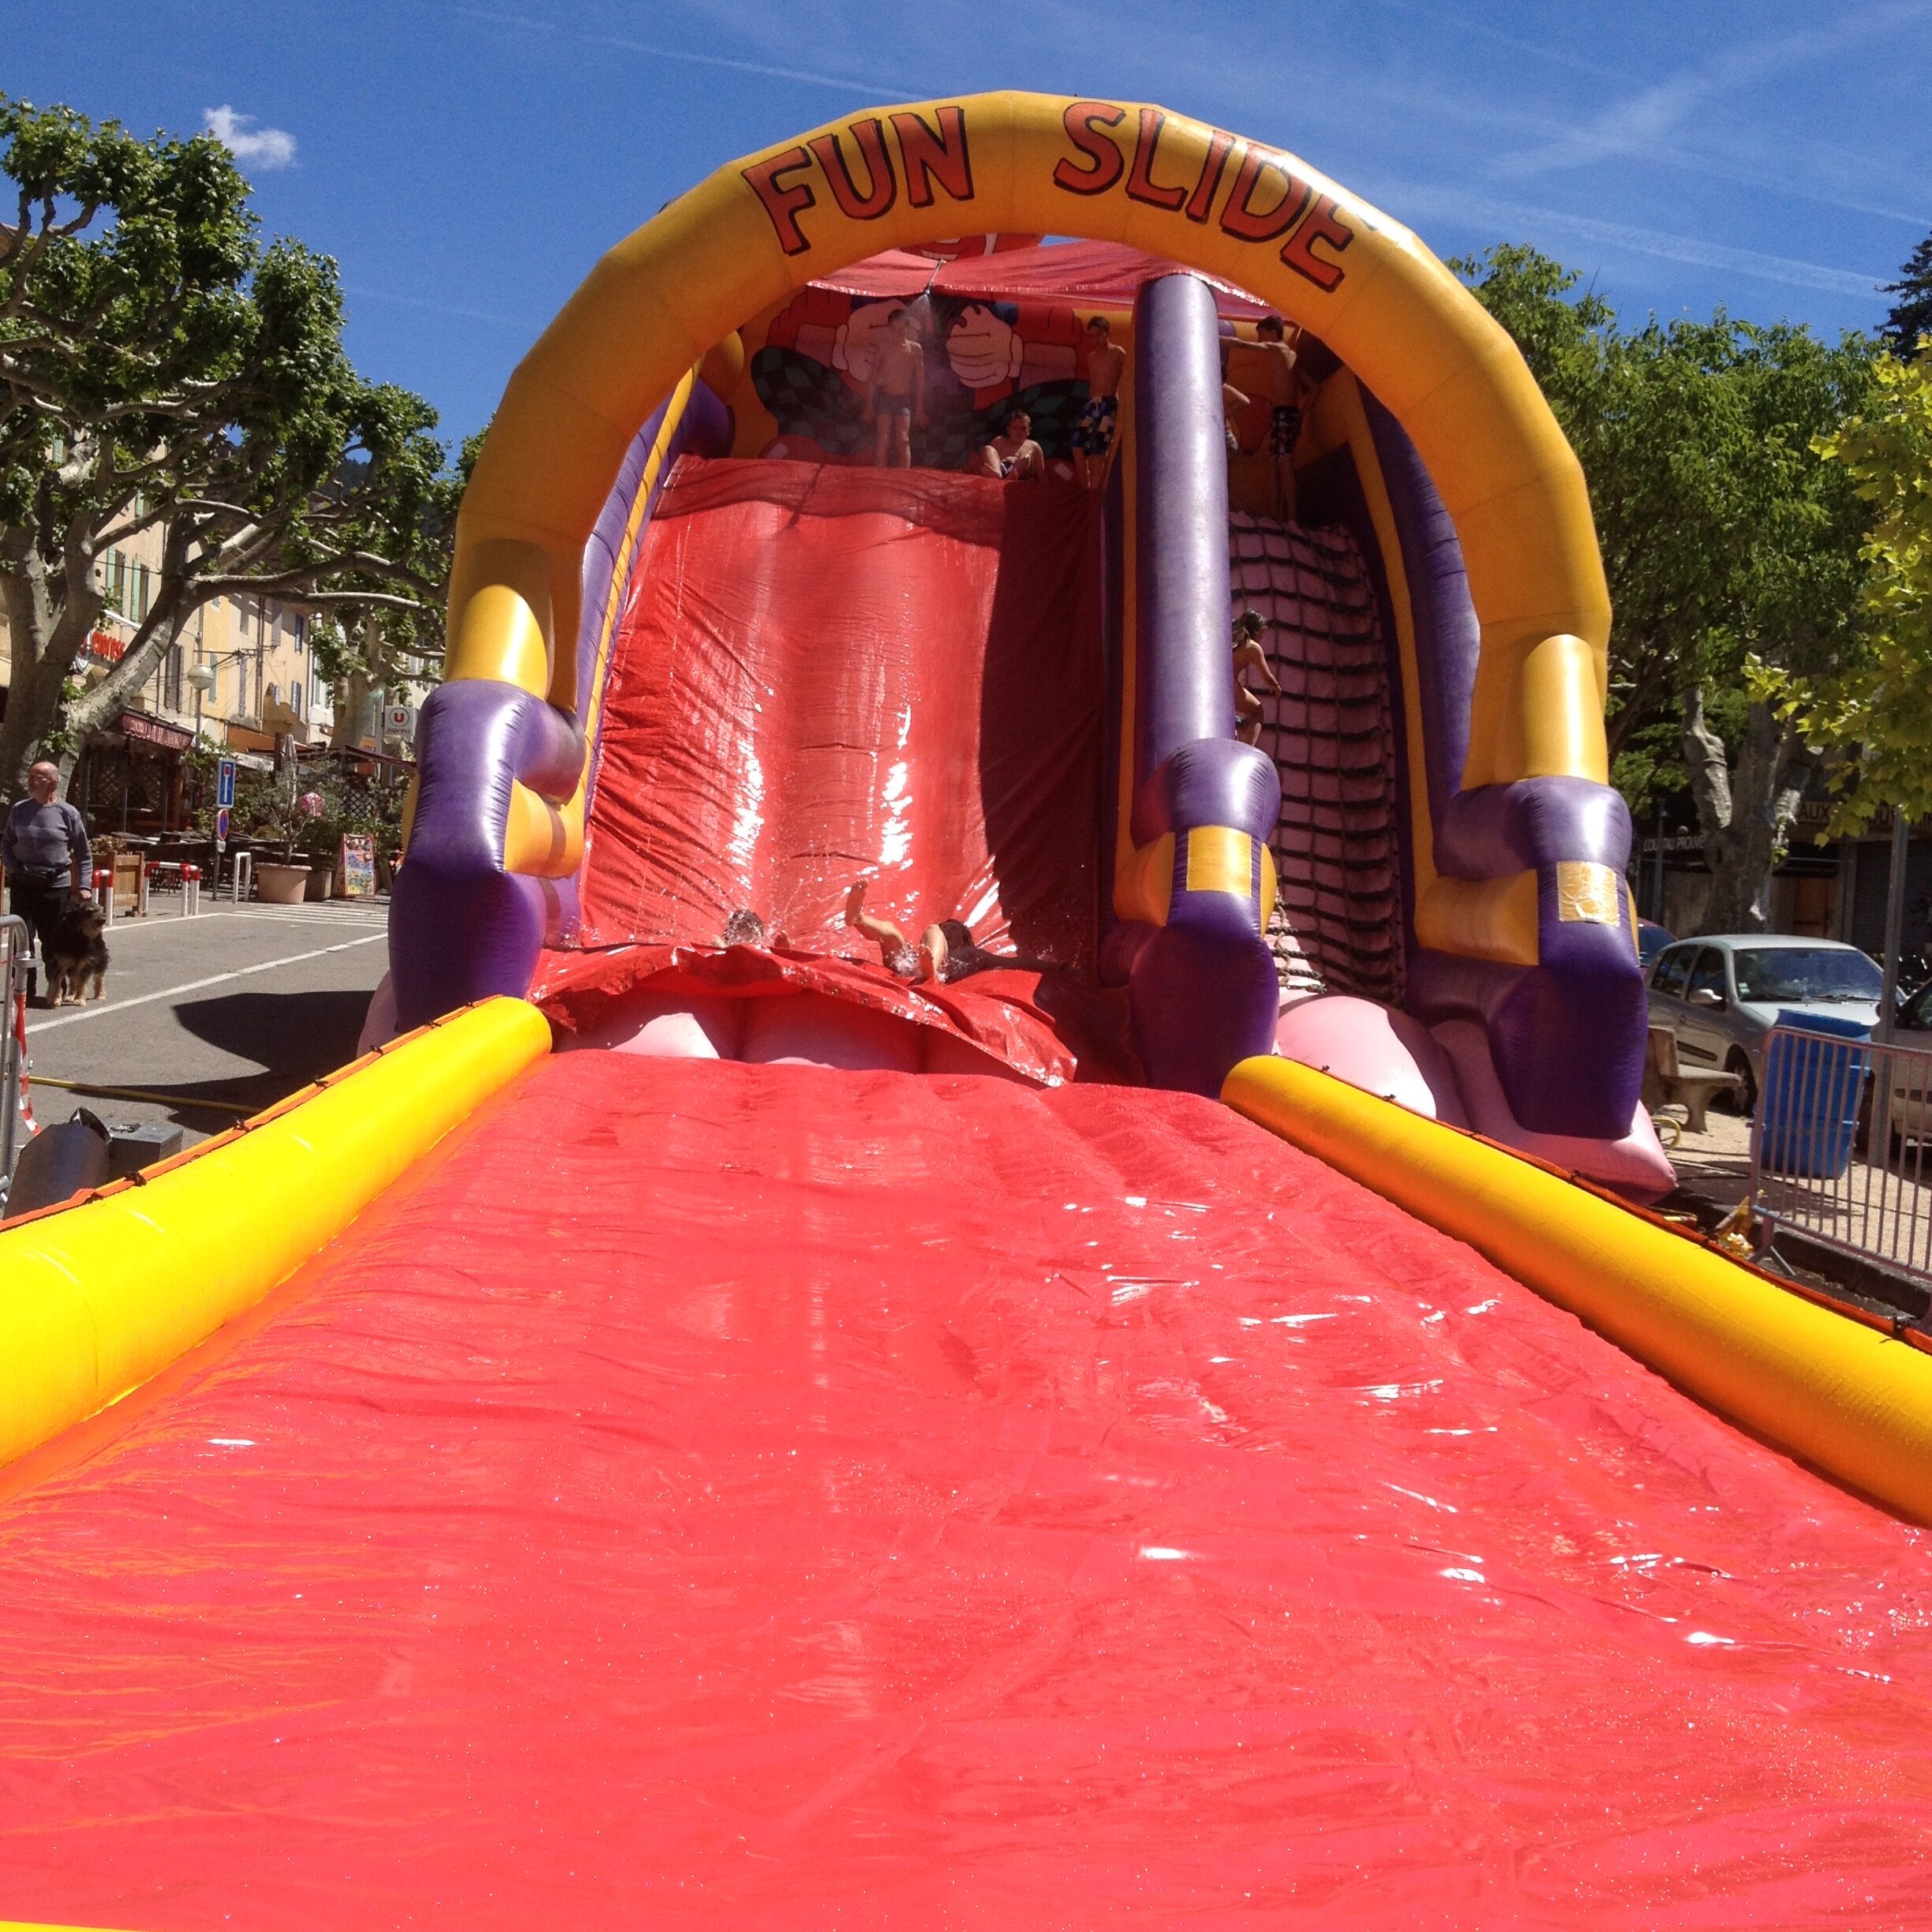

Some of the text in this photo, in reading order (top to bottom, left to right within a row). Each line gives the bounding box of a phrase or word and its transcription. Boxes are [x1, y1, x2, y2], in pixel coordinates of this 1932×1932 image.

[741, 102, 1378, 294] FUN SLIDE
[394, 713, 405, 723] U
